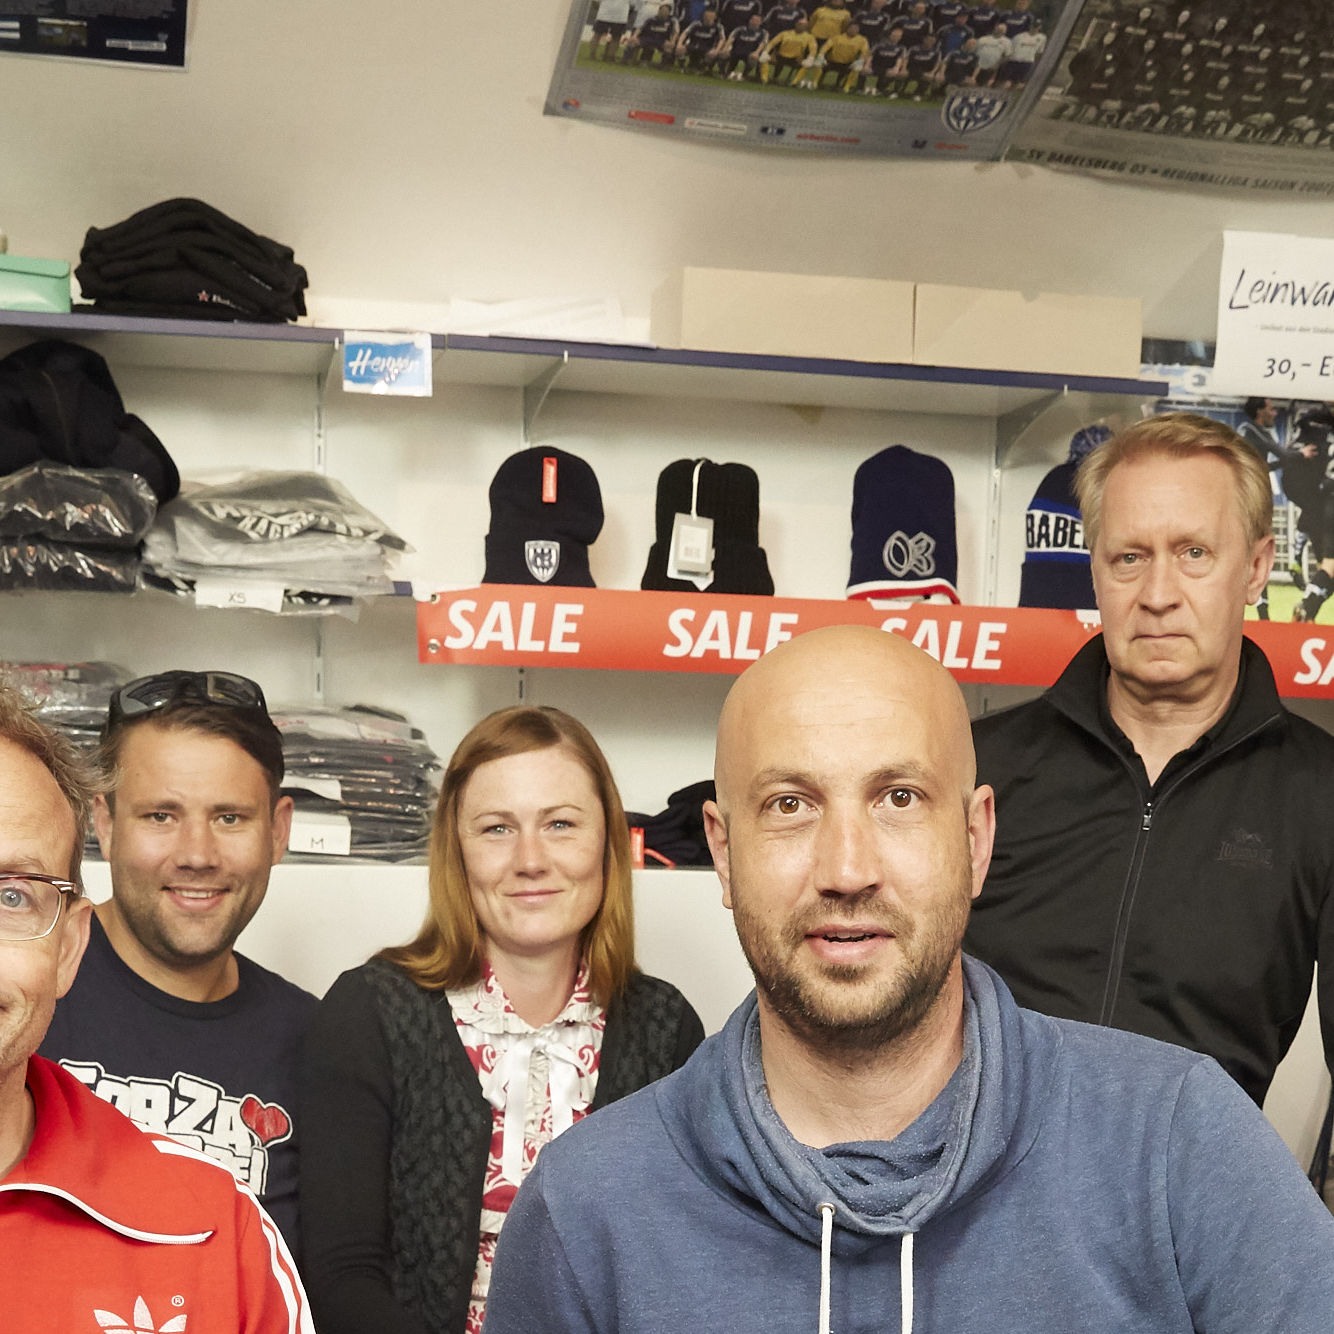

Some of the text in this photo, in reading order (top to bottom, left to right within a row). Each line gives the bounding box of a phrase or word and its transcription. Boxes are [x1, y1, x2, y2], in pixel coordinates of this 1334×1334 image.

[1025, 513, 1088, 549] BABE
[882, 530, 937, 578] 03
[227, 592, 248, 604] XS
[444, 599, 585, 654] SALE
[310, 837, 325, 850] M
